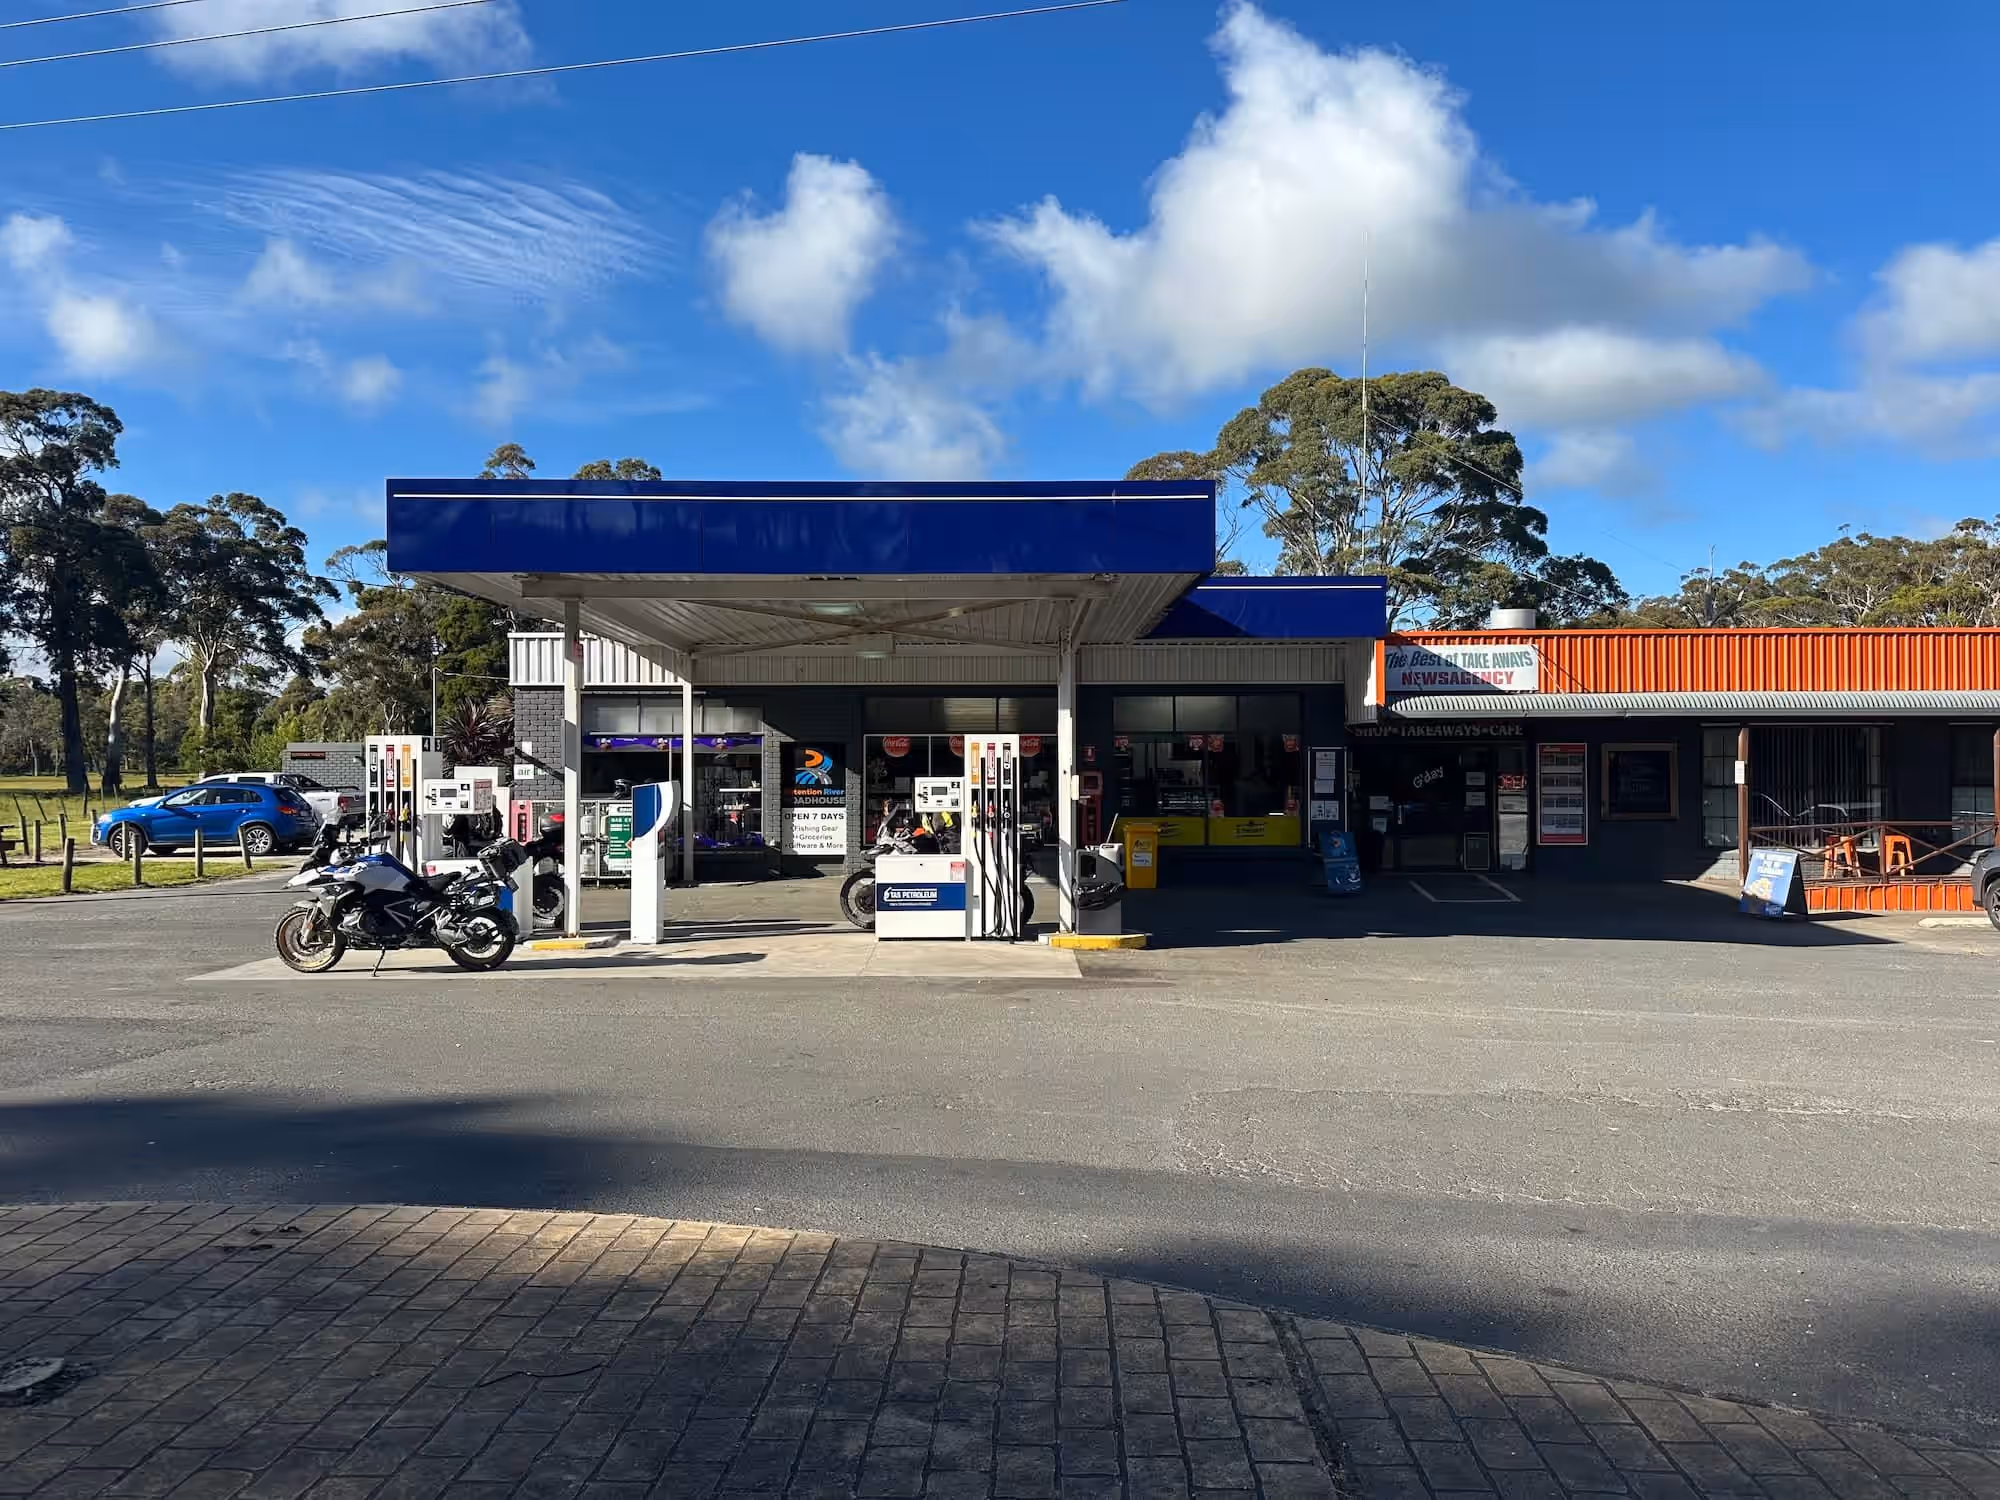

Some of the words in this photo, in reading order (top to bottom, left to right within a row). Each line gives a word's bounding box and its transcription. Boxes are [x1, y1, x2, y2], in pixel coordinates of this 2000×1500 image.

[1385, 653, 1408, 668] The
[1410, 651, 1443, 666] Best
[1445, 652, 1458, 668] of
[1461, 653, 1490, 668] TAKE
[1492, 651, 1533, 668] AWAYS
[1402, 671, 1514, 685] NEWSAGENCY
[517, 768, 531, 776] air
[793, 788, 822, 796] tention
[823, 788, 844, 796] River
[793, 796, 846, 804] OADHOUSE
[794, 825, 820, 833] Fishing
[902, 891, 937, 899] PETROLEUM
